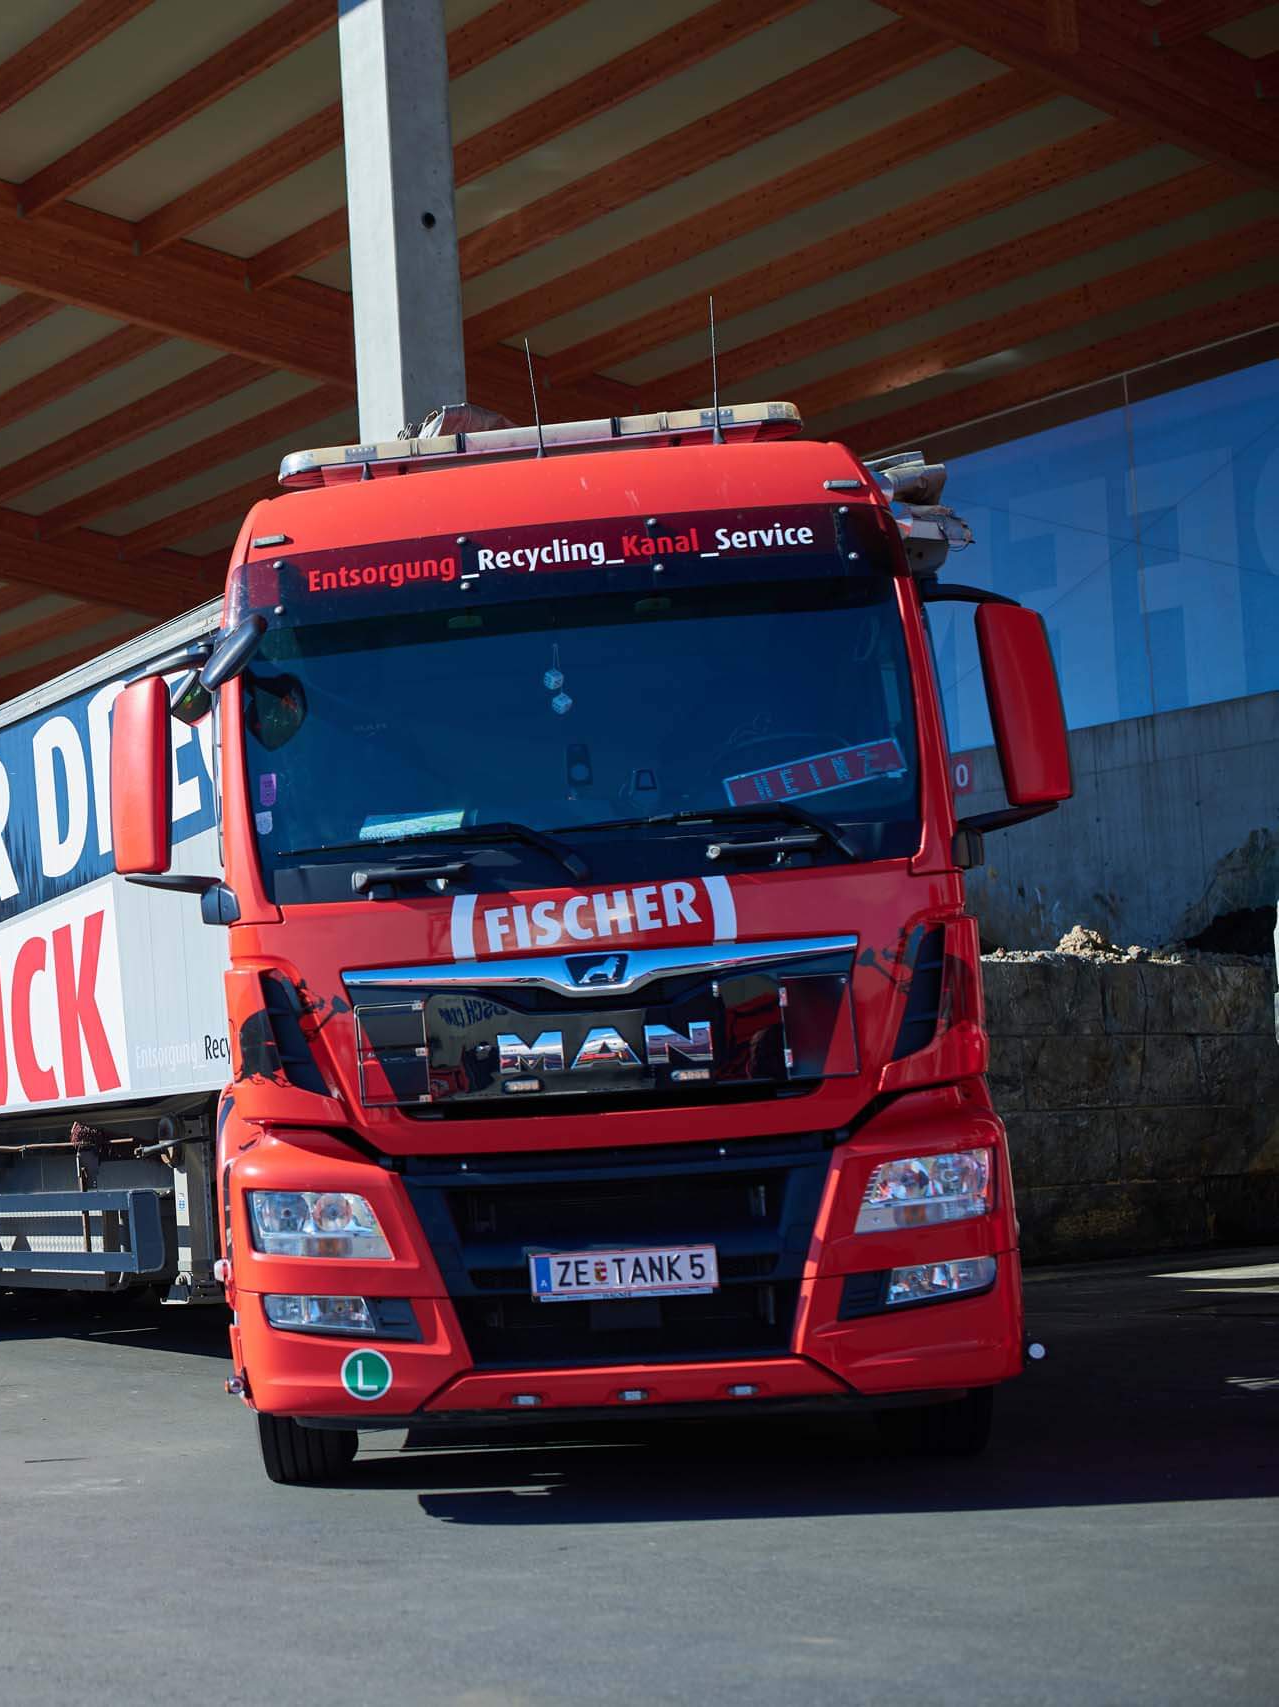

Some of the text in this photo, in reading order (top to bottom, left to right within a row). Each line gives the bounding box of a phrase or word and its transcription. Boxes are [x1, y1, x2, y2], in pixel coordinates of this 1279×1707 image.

[307, 554, 456, 593] Entsorgung
[483, 881, 703, 953] FISCHER
[496, 1021, 714, 1075] MAN
[556, 1252, 706, 1287] ZE TANK 5
[356, 1360, 378, 1391] L
